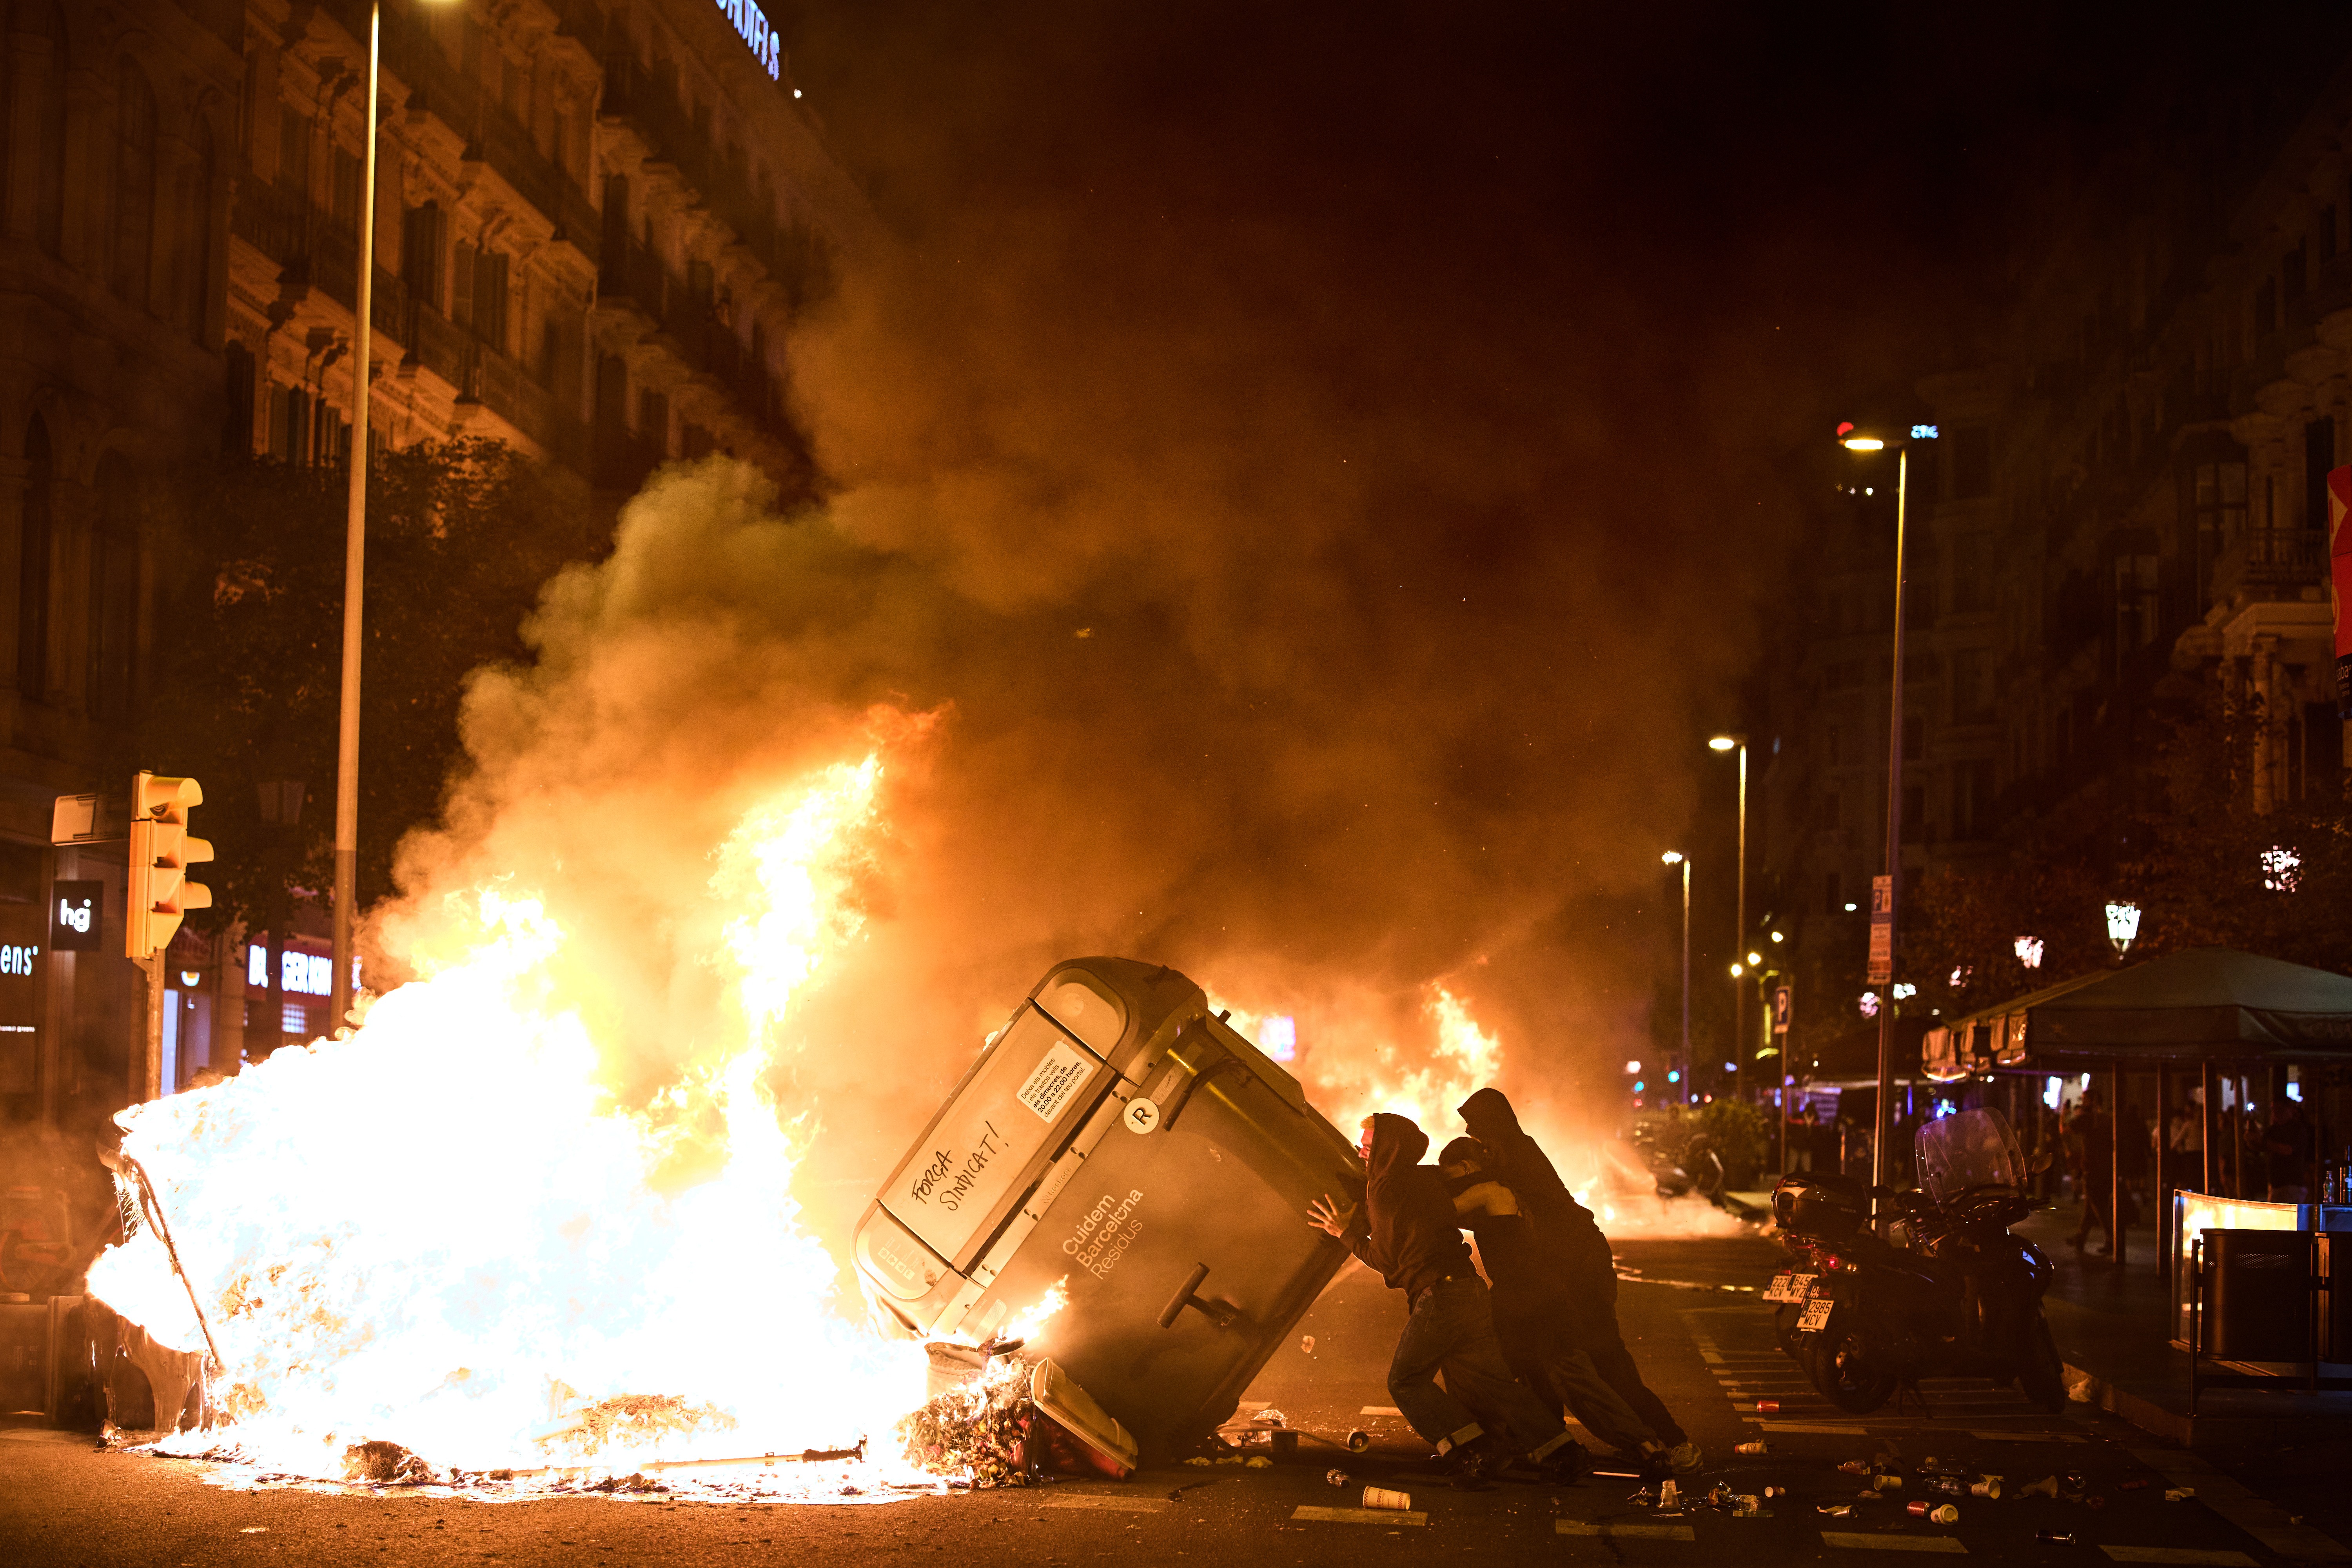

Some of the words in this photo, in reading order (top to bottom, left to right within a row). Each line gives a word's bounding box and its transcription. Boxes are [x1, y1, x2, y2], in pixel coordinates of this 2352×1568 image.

[249, 944, 309, 994] BUGER
[1779, 991, 1787, 1021] P
[1021, 1084, 1034, 1099] Deixa
[1040, 1058, 1055, 1077] mobles
[1035, 1076, 1051, 1093] trastos
[1049, 1064, 1060, 1076] vells
[1038, 1096, 1052, 1113] 20.00
[1053, 1077, 1067, 1093] 22.00
[1065, 1062, 1082, 1078] hores,
[1040, 1075, 1062, 1100] dimecres,
[1044, 1100, 1059, 1118] davant
[1058, 1091, 1066, 1101] del
[1064, 1083, 1073, 1092] teu
[1071, 1067, 1085, 1085] portal.
[1132, 1107, 1152, 1125] R
[940, 1120, 1009, 1211] SINDICAT!
[1063, 1195, 1116, 1255] Cuidem
[1076, 1189, 1143, 1268] Barcelona
[1090, 1220, 1143, 1280] Residus
[1769, 1288, 1784, 1297] KCV
[1789, 1287, 1806, 1298] MYZ
[1808, 1301, 1831, 1314] 2985
[1803, 1314, 1822, 1326] MCV
